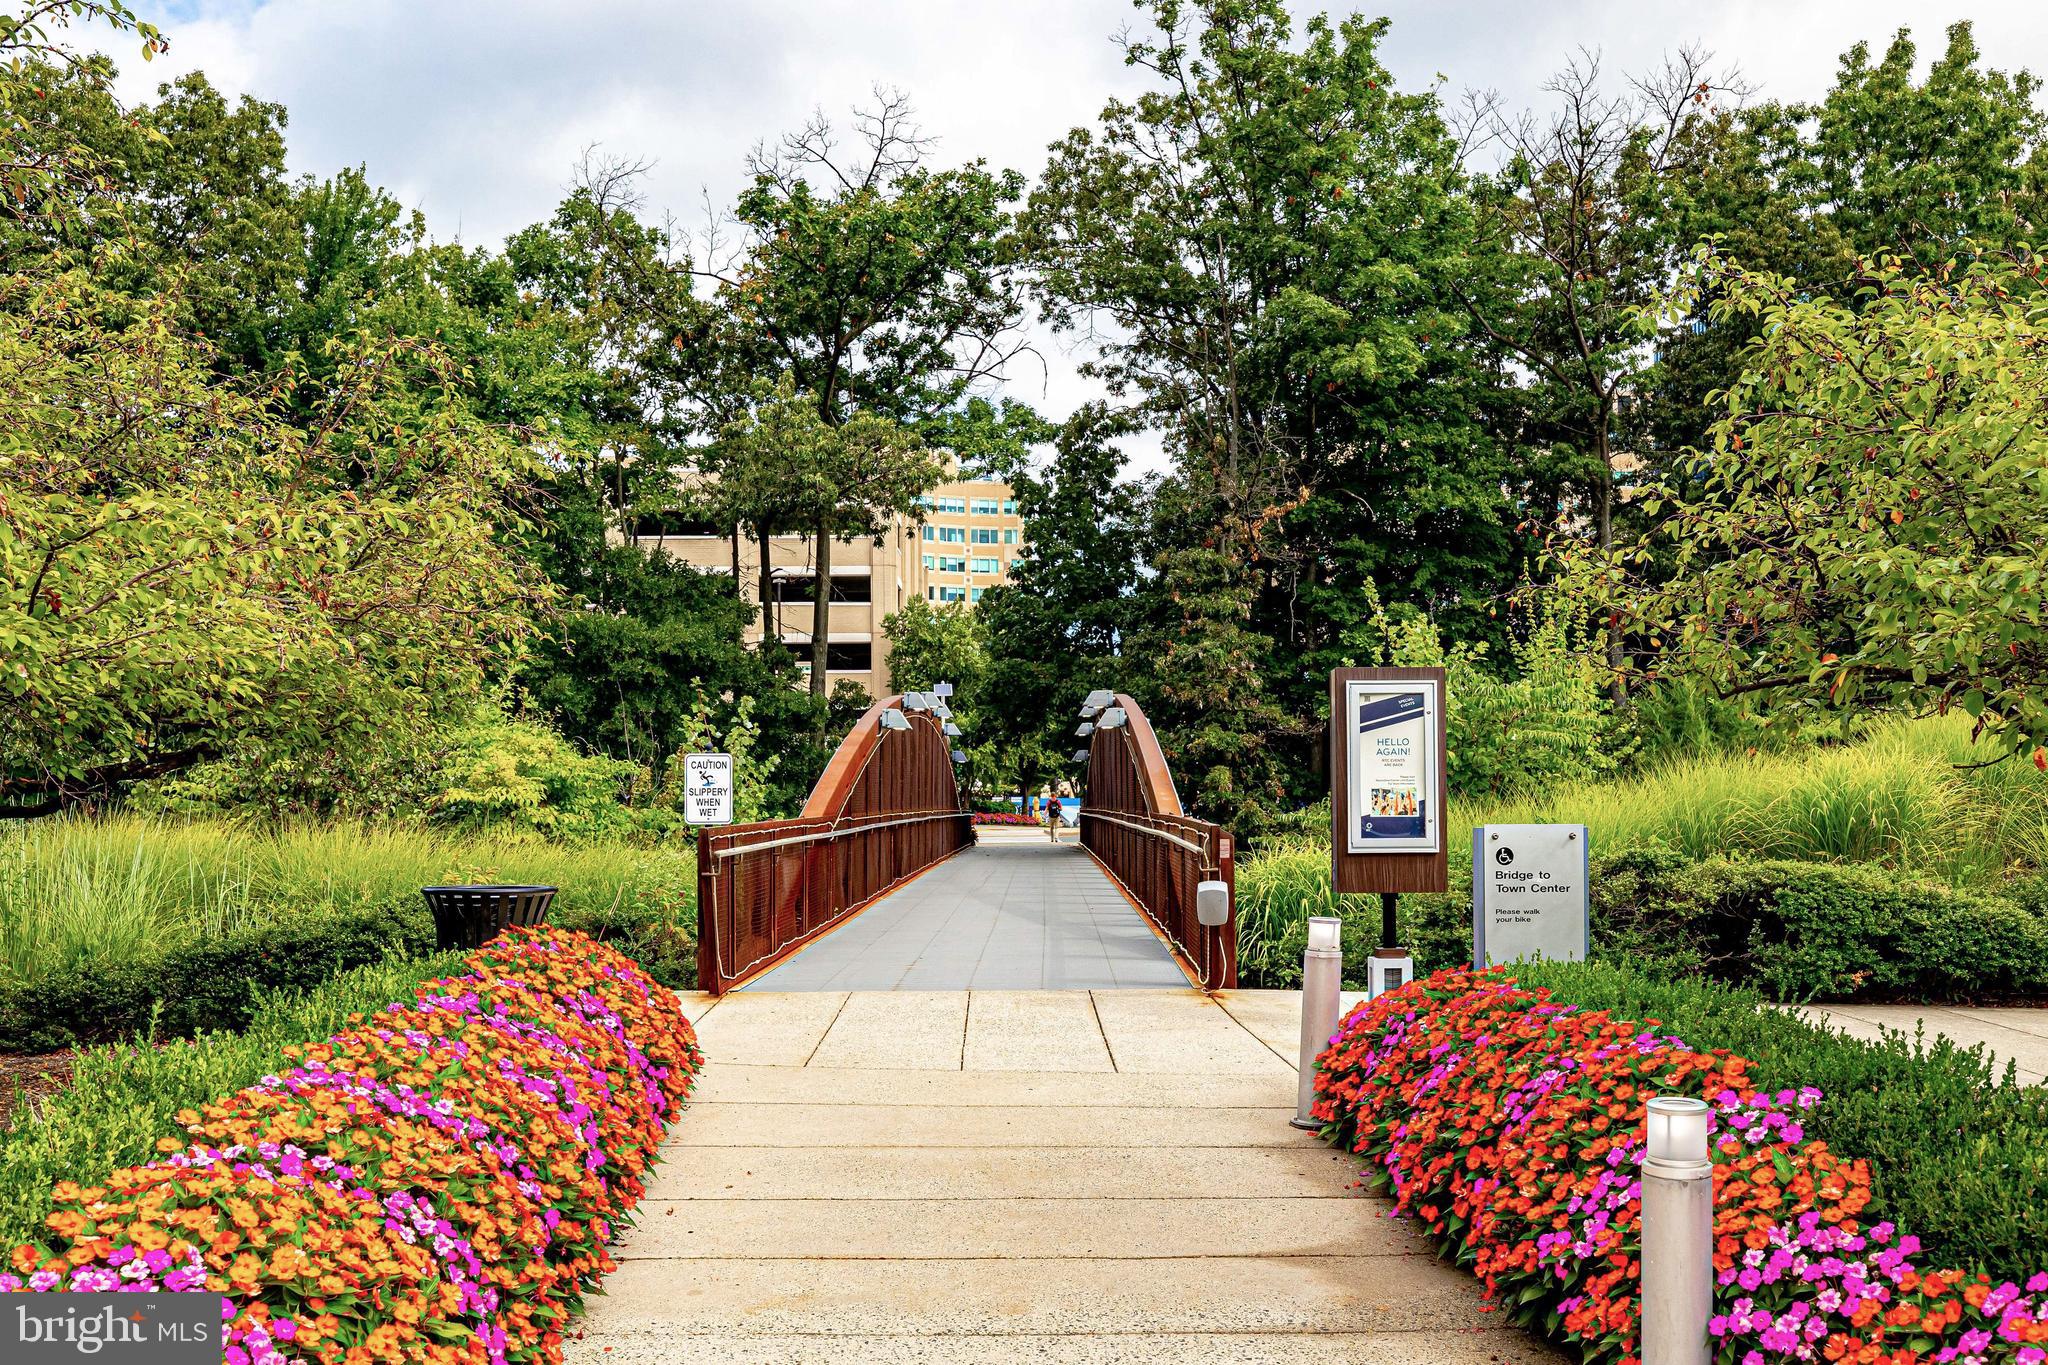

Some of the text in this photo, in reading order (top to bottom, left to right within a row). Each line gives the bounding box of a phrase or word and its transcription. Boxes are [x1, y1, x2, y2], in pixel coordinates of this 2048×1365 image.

[1377, 738, 1410, 746] HELLO
[1376, 748, 1411, 756] AGAIN!
[691, 761, 727, 769] CAUTION
[688, 788, 728, 796] SLIPPERY
[696, 798, 720, 806] WHEN
[699, 808, 717, 816] WET
[1495, 871, 1551, 881] Bridge to
[1496, 883, 1571, 893] Town Center
